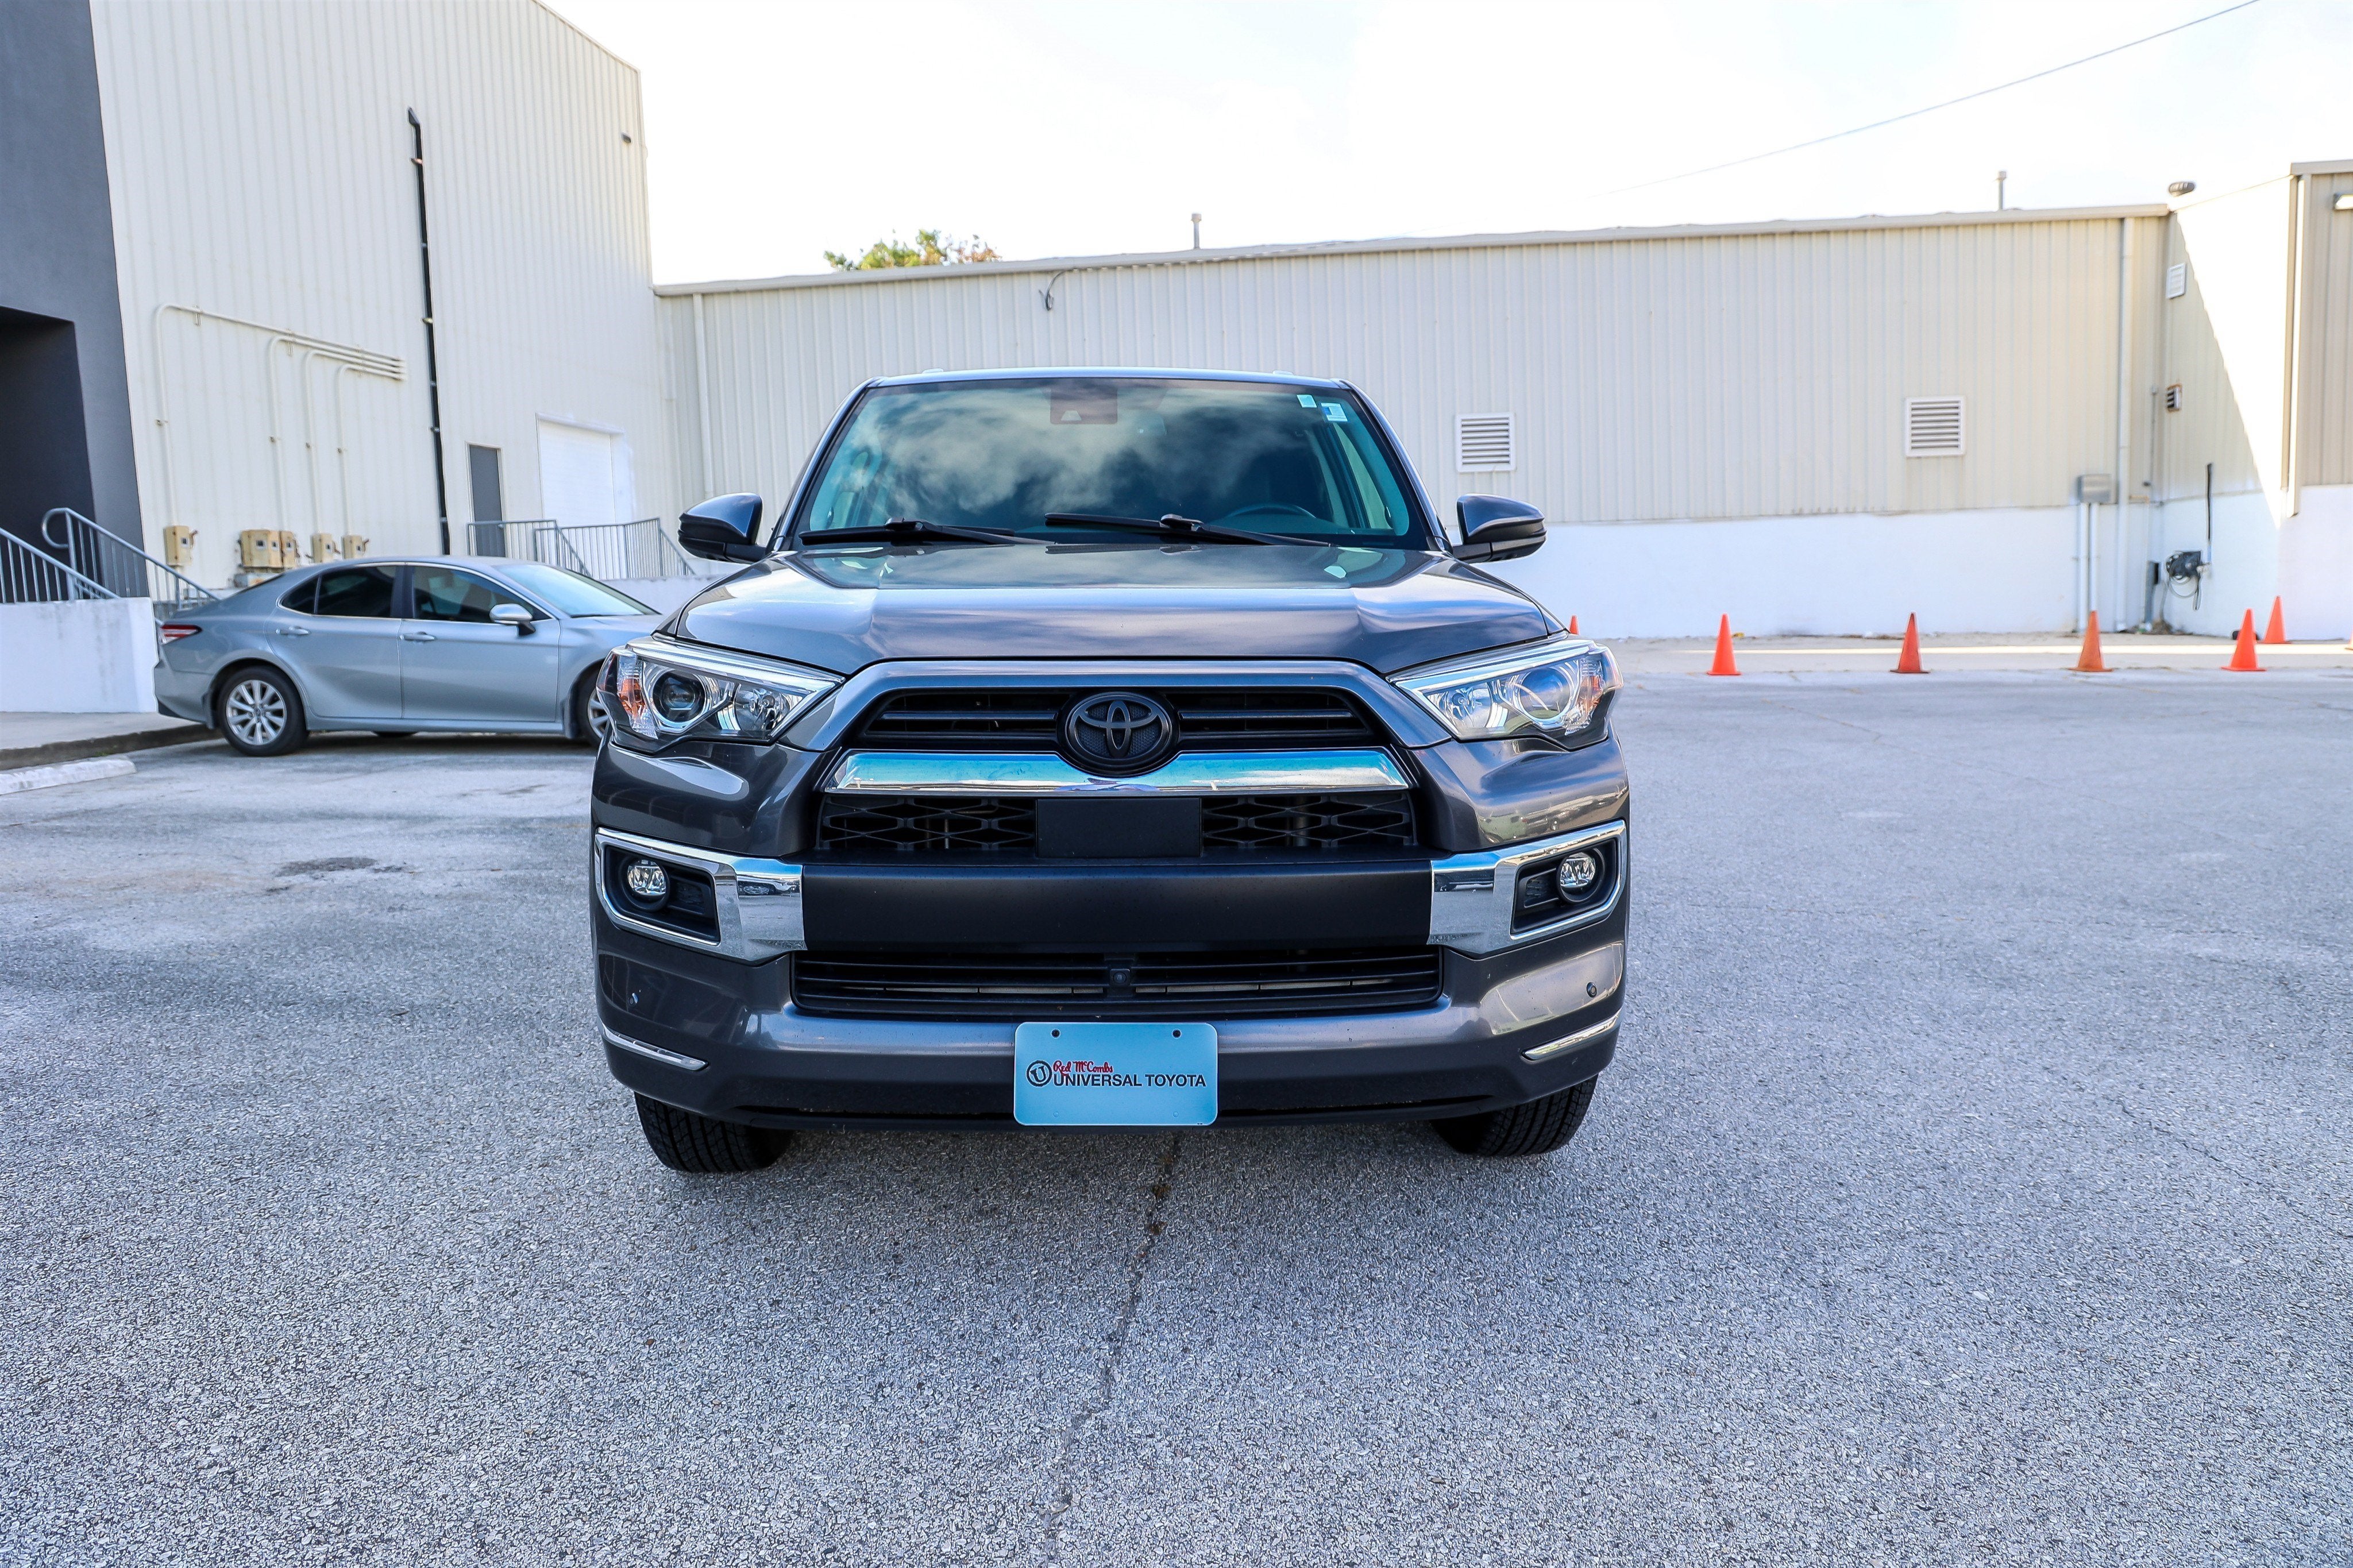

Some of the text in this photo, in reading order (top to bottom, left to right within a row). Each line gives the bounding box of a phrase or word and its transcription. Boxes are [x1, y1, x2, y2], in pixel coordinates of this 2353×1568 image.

[1053, 1060, 1113, 1076] Red McCombs
[1054, 1073, 1206, 1087] UNIVERSAL TOYOTA
